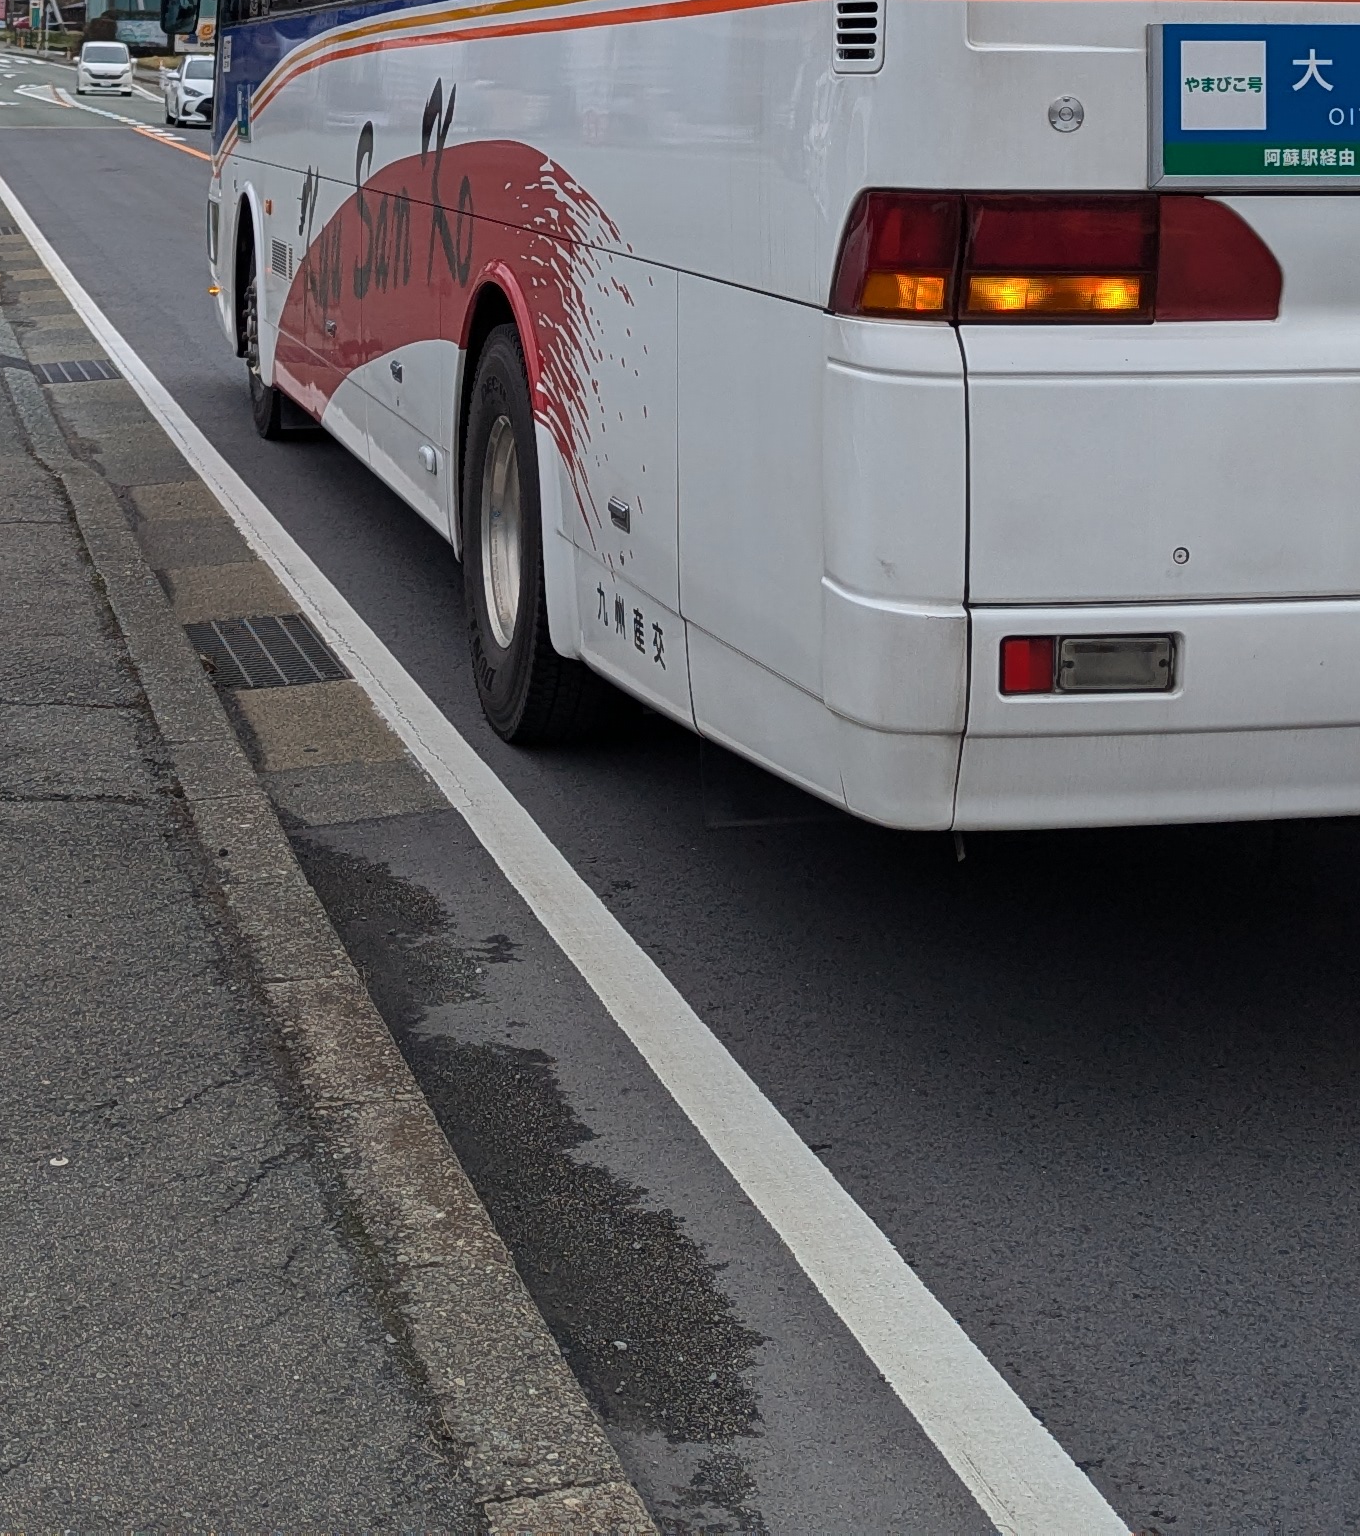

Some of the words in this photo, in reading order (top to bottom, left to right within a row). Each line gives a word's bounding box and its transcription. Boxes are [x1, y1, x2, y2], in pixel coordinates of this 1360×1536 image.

[1183, 75, 1264, 94] やまびこ号
[1263, 147, 1356, 167] 阿蘇駅経由
[353, 120, 412, 300] San
[422, 76, 474, 289] Ko
[596, 581, 667, 671] 九州産交
